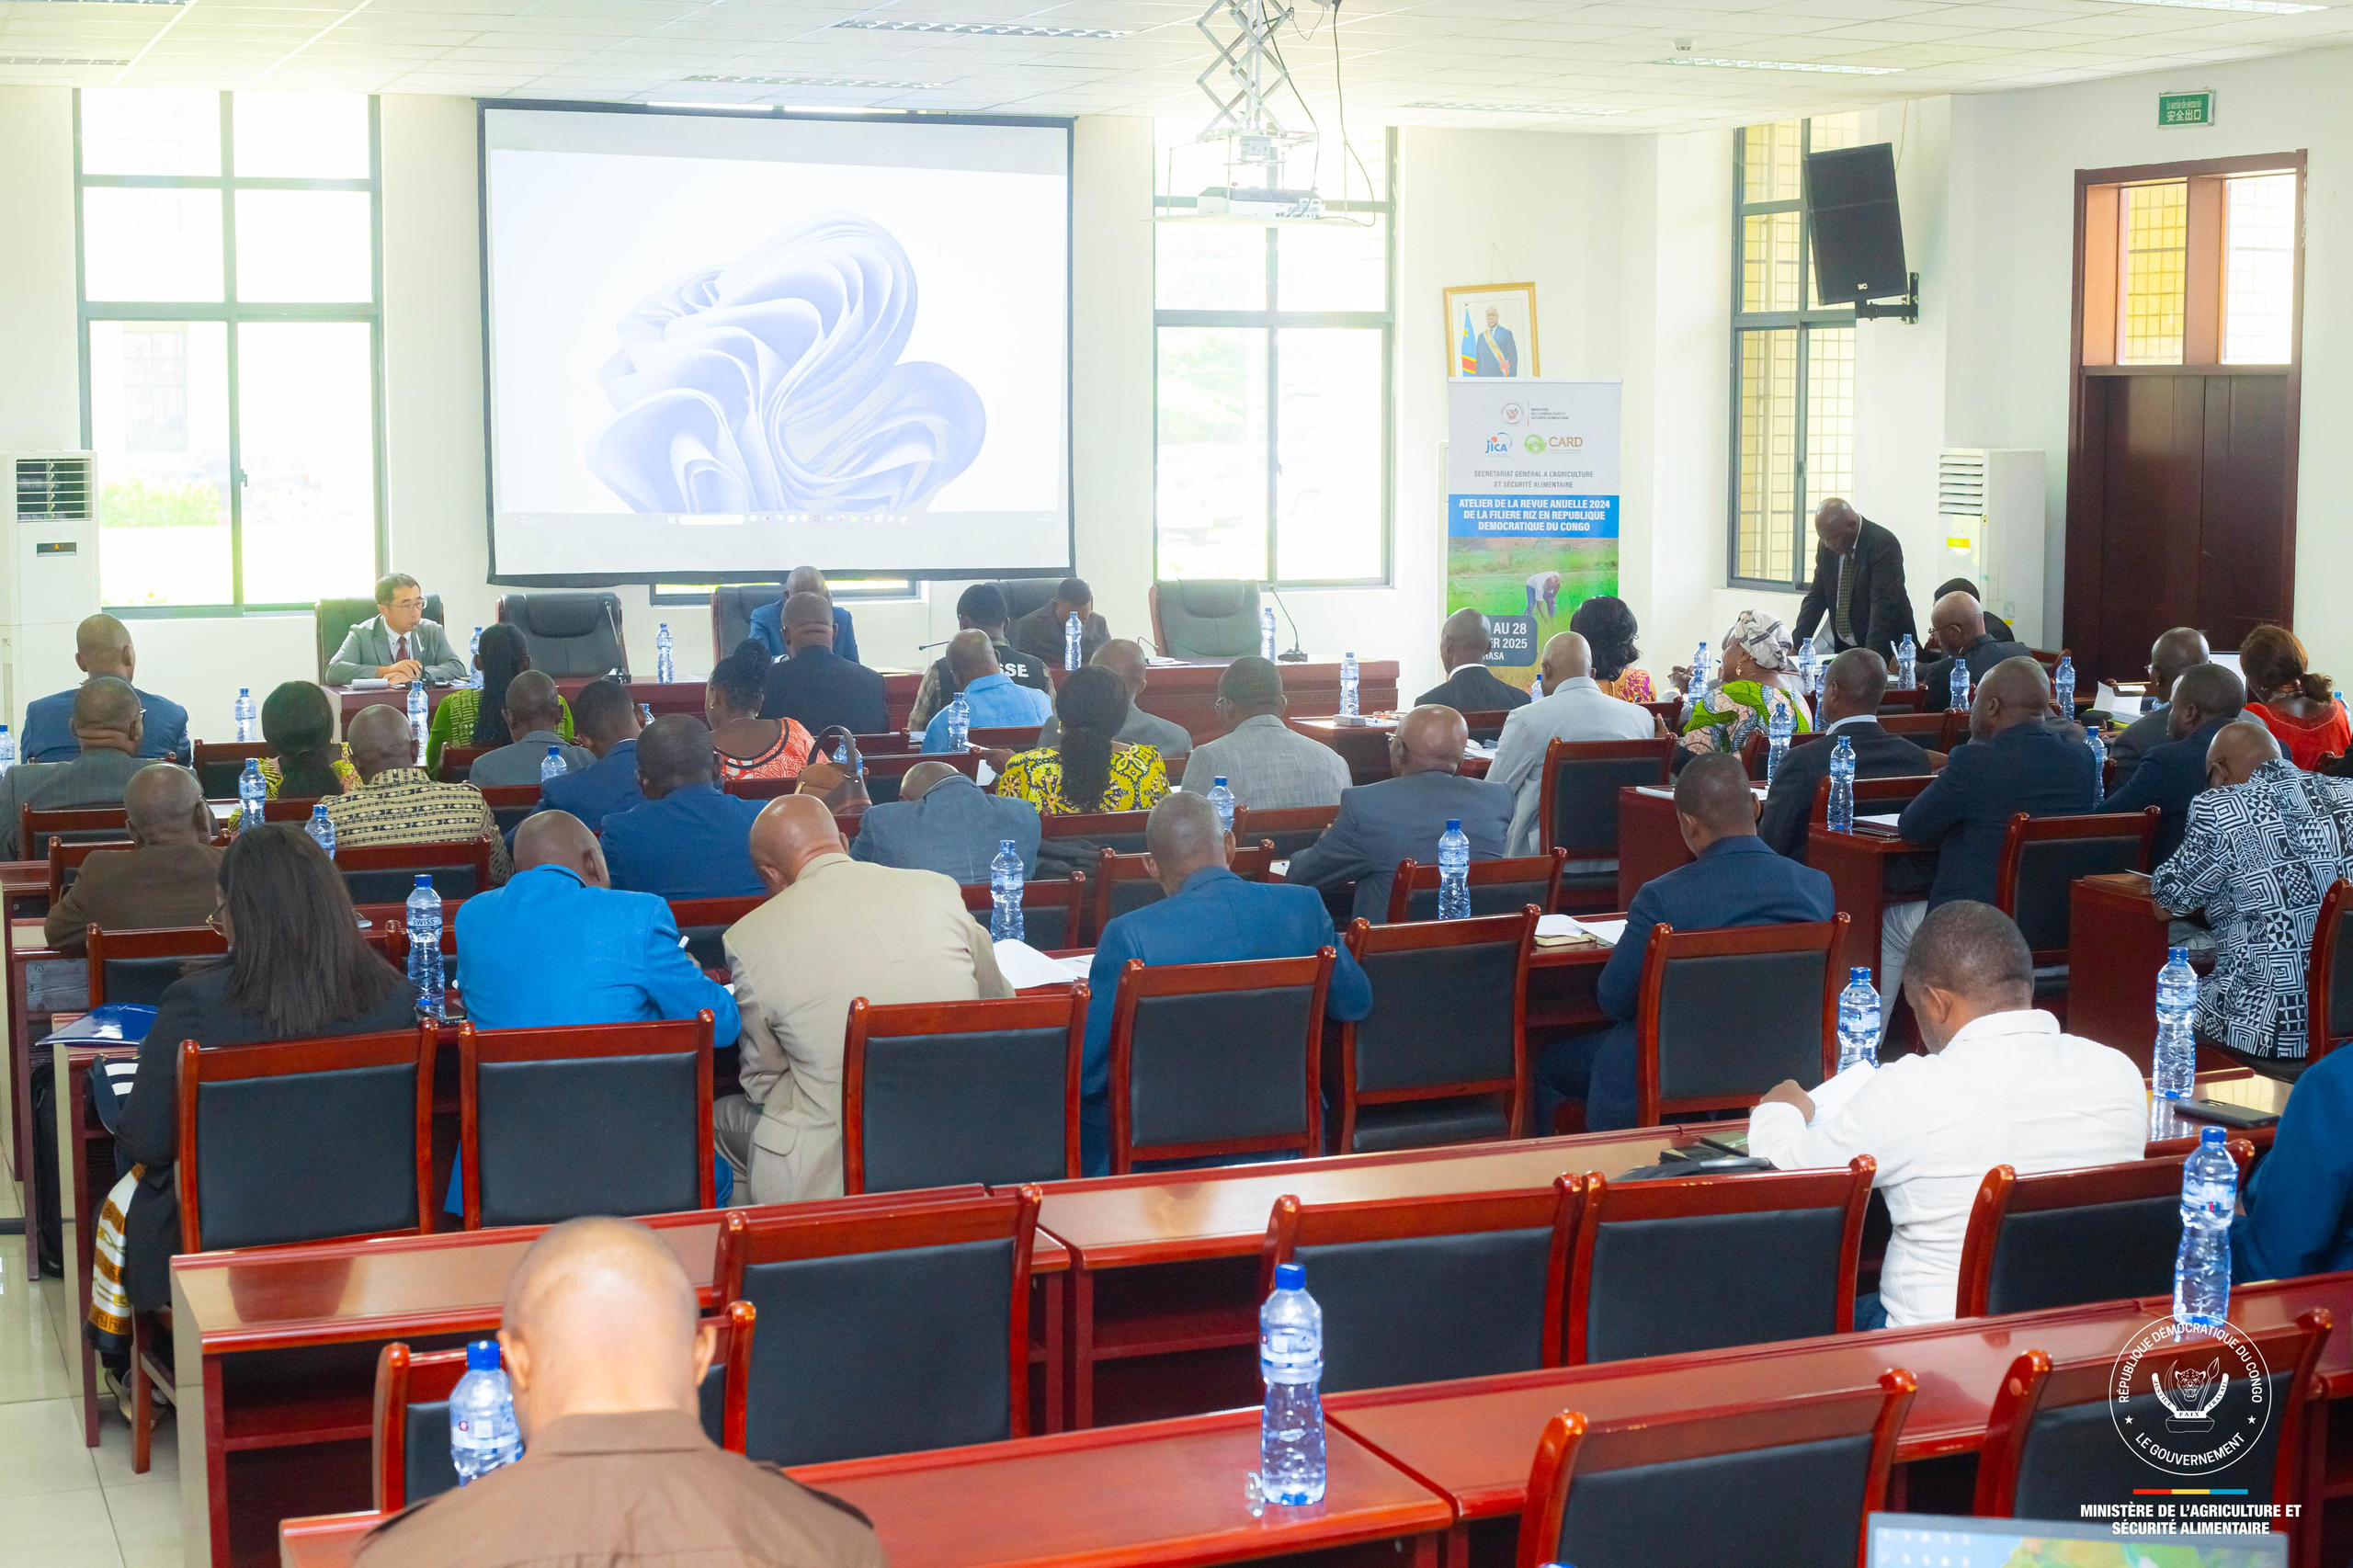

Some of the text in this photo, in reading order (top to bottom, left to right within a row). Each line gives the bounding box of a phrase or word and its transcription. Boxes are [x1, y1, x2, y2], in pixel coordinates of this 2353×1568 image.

[2166, 109, 2201, 121] 安全出口
[1549, 437, 1583, 448] CARD
[1473, 470, 1514, 478] SECRÉTARIAT
[1459, 499, 1610, 508] ATELIER DE LA REVUE ANUELLE 2024
[1464, 510, 1605, 520] DE LA FILIERE RIZ EN REPUBLIQUE
[1479, 522, 1590, 531] DEMOCRATIQUE DU CONGO
[1494, 622, 1527, 634] AU 28
[1502, 638, 1528, 648] 2025
